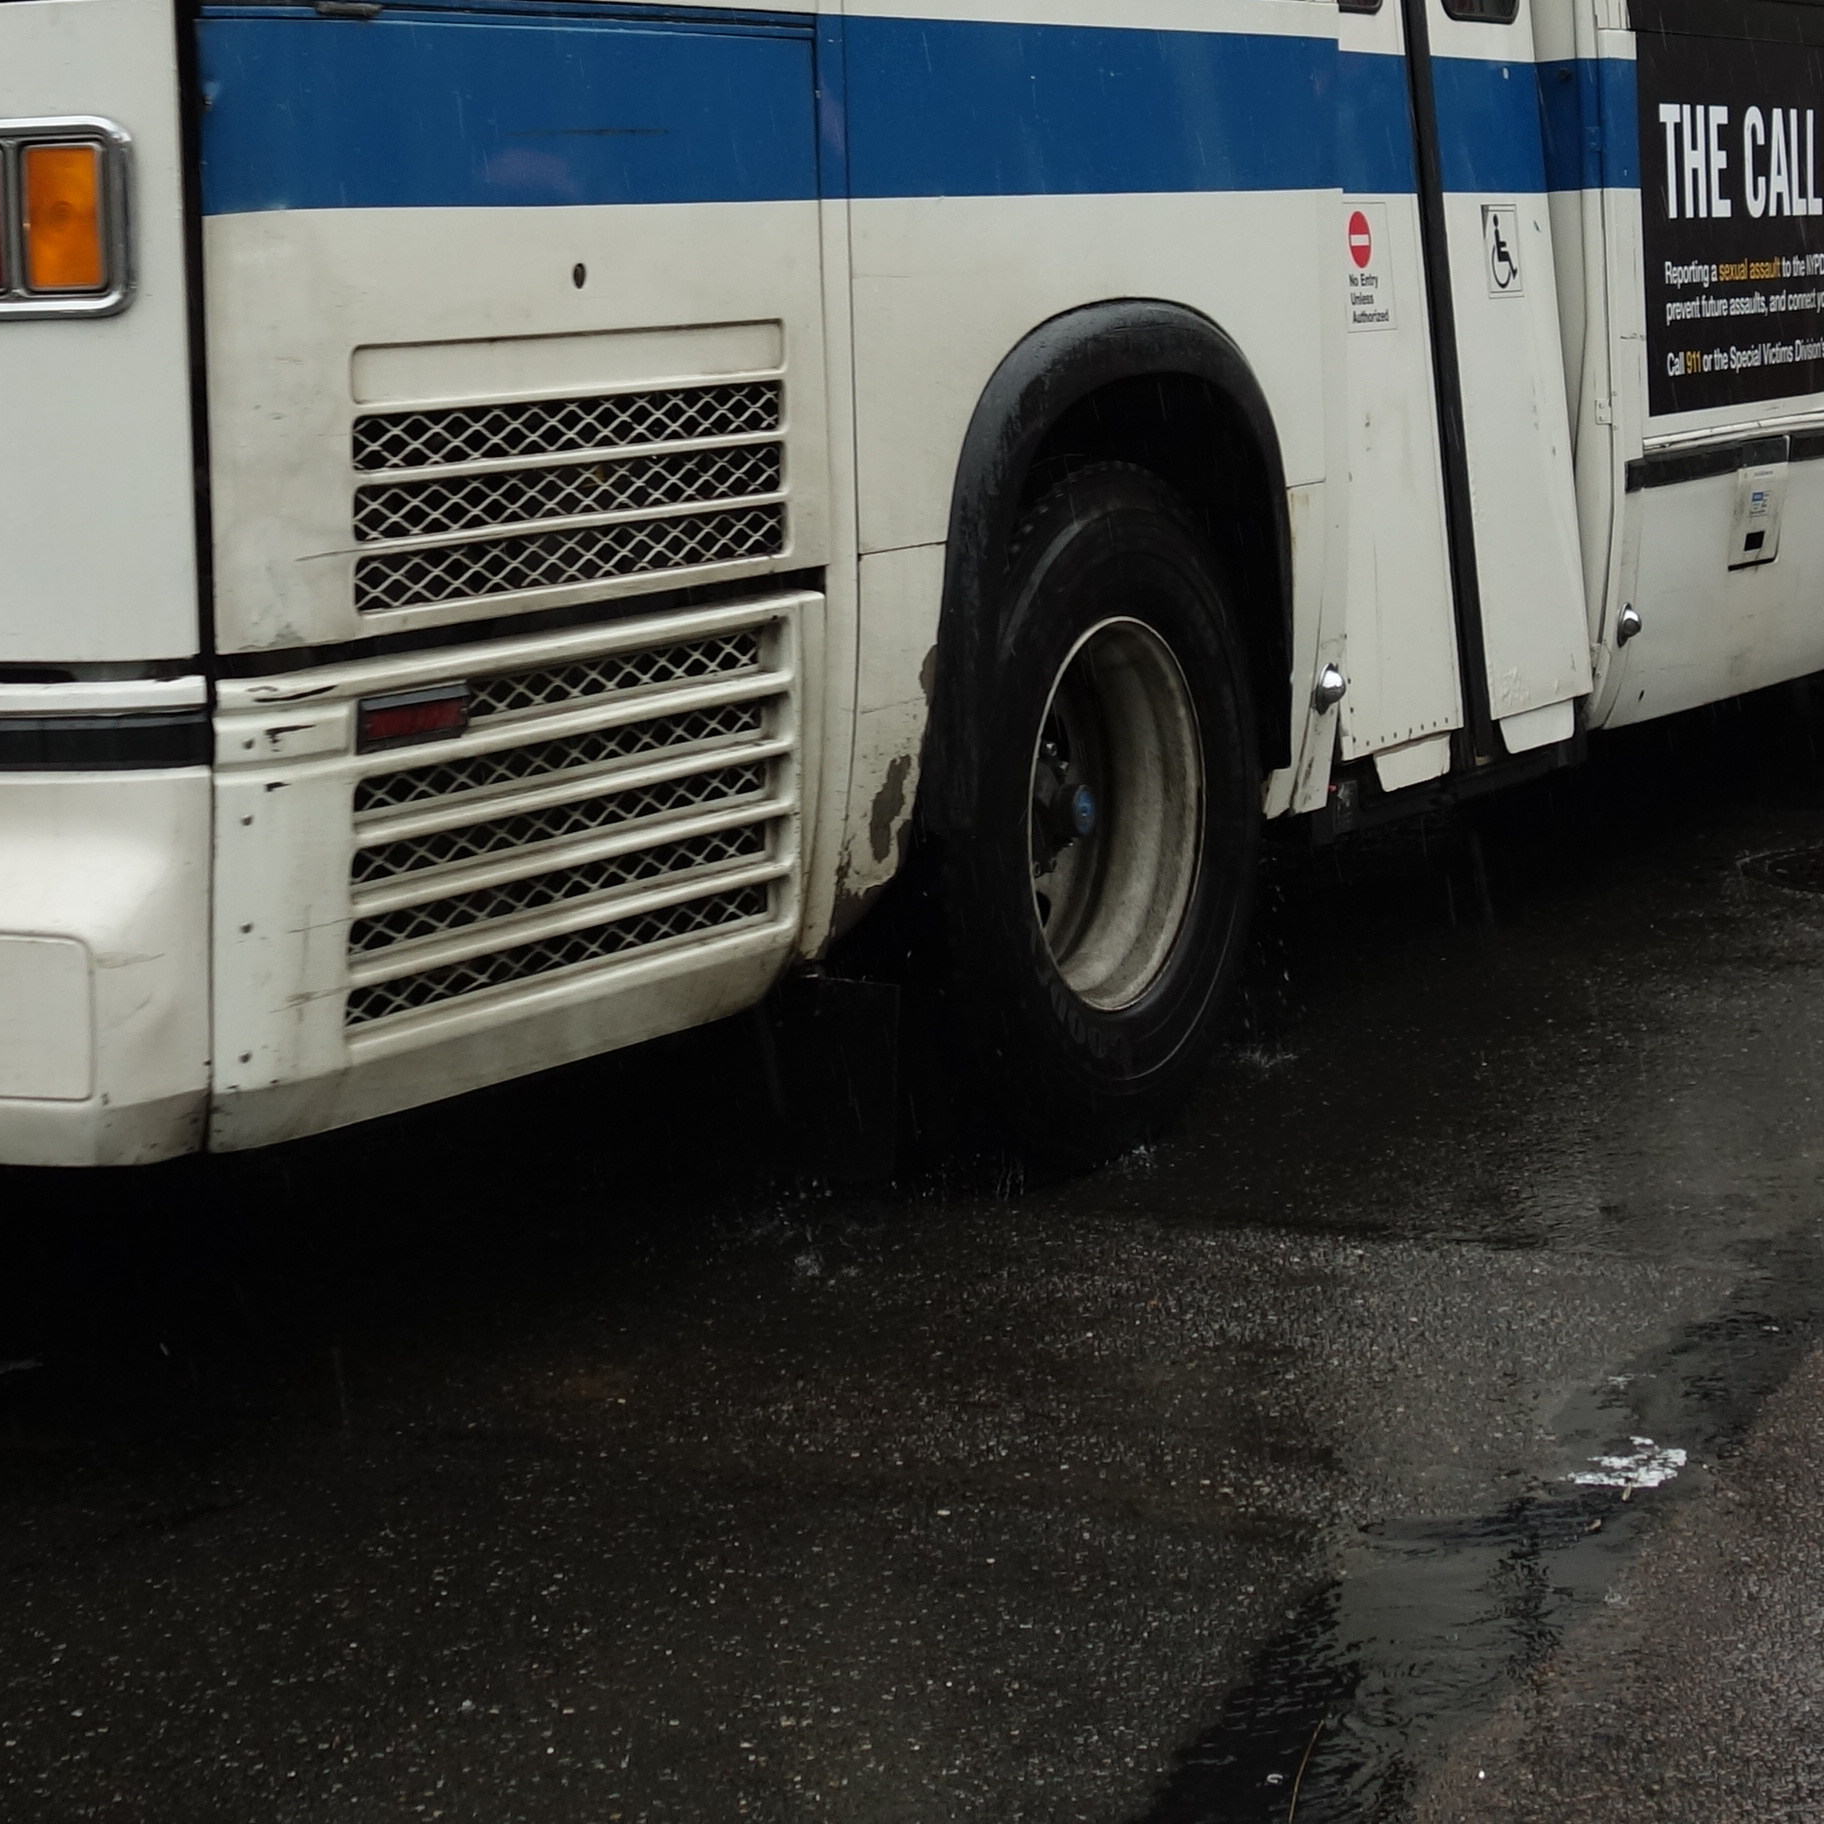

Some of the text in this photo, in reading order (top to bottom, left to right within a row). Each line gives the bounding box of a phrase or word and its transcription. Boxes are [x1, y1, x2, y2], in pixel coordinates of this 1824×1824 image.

[1659, 102, 1732, 219] THE
[1743, 105, 1823, 218] CALL
[1349, 273, 1379, 289] No Entry
[1665, 259, 1709, 289] Reporting
[1711, 263, 1718, 282] a
[1719, 258, 1748, 281] sexual
[1749, 256, 1781, 279] assault
[1782, 256, 1791, 277] to
[1793, 254, 1805, 276] the
[1350, 292, 1374, 306] Unless
[1352, 309, 1390, 324] Authorized
[1666, 296, 1701, 326] prevent
[1702, 294, 1727, 318] future
[1729, 290, 1769, 317] assaults,
[1769, 289, 1786, 313] and
[1787, 288, 1816, 311] connect
[1667, 351, 1685, 377] Call
[1686, 350, 1702, 375] 911
[1703, 353, 1712, 372] or
[1713, 347, 1729, 371] the
[1729, 343, 1761, 374] Special
[1762, 341, 1794, 365] Victims
